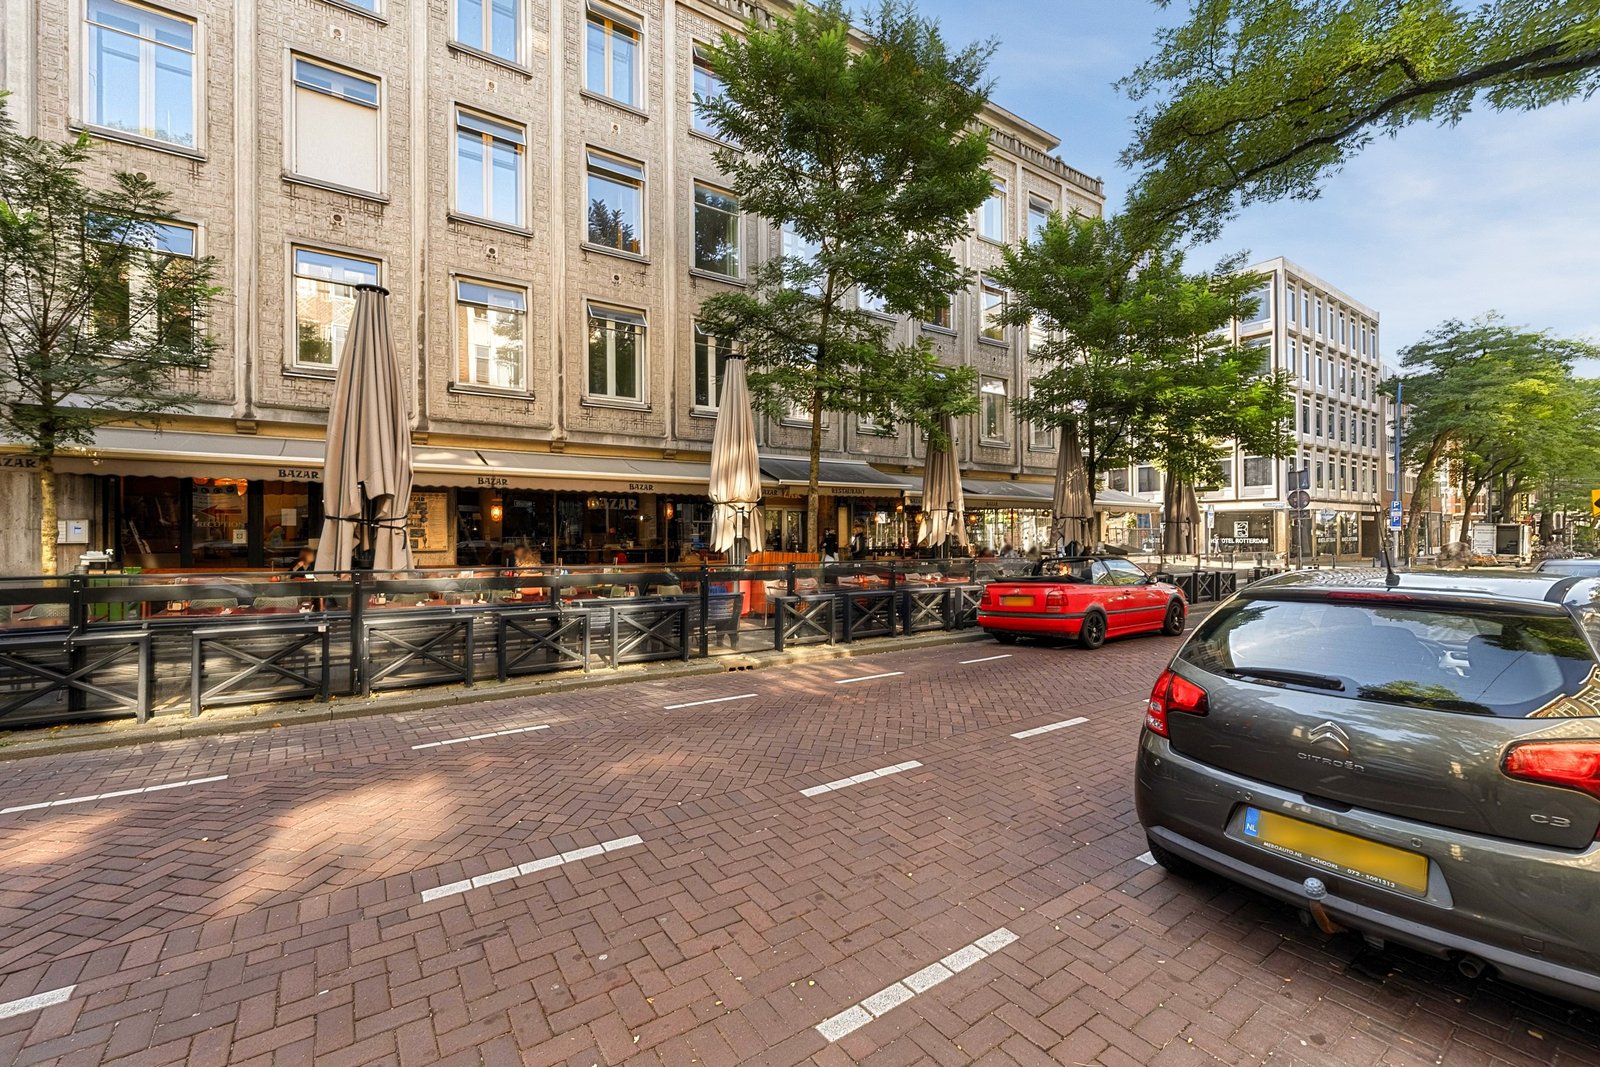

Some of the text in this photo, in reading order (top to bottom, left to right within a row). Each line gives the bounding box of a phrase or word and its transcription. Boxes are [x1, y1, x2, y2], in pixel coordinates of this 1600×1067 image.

[0, 458, 37, 468] ZAR
[278, 469, 320, 479] BAZAR
[477, 477, 509, 486] BAZAR
[629, 483, 654, 491] BAZAR
[831, 487, 865, 495] RESTAURANT
[761, 488, 779, 496] AZAR
[196, 521, 245, 529] RECEPTION
[1530, 813, 1571, 828] C3
[1246, 823, 1257, 832] NL
[1310, 856, 1339, 870] SCHOORL
[1347, 868, 1360, 877] 072
